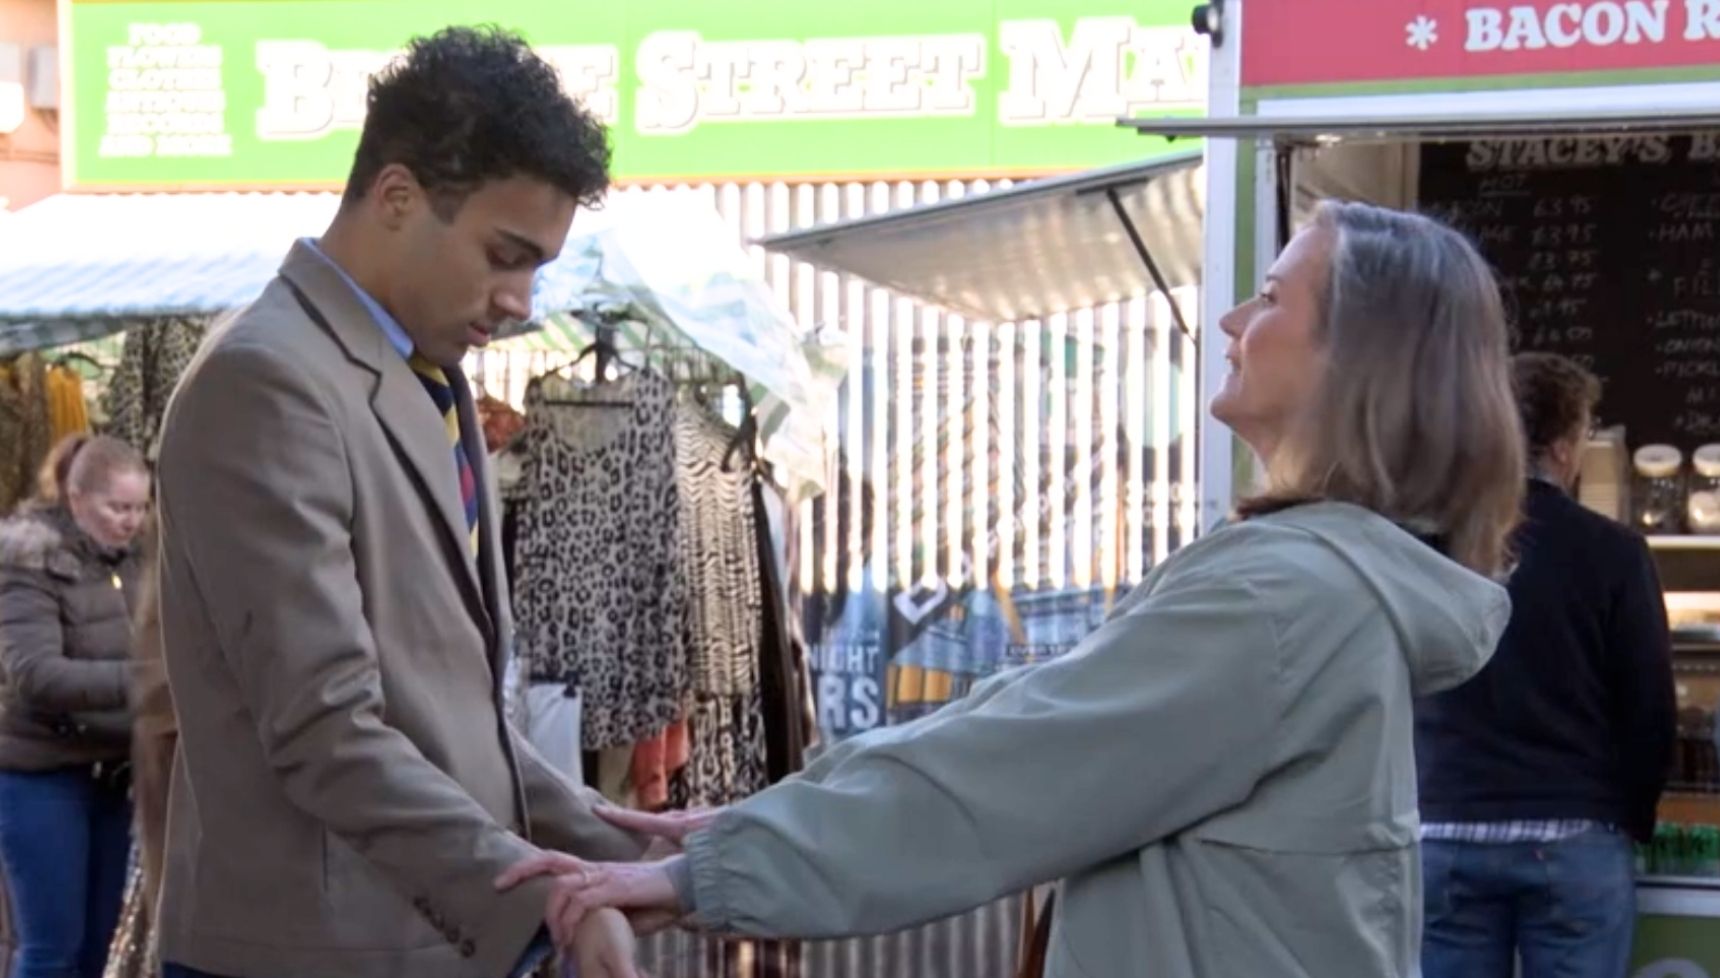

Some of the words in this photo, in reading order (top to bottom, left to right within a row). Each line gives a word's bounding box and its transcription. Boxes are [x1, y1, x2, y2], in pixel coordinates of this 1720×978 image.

[1465, 0, 1668, 50] BACON
[636, 33, 983, 132] STREET
[1001, 20, 1206, 124] MA
[1465, 138, 1670, 169] STACEY'S
[1658, 221, 1713, 242] HAM
